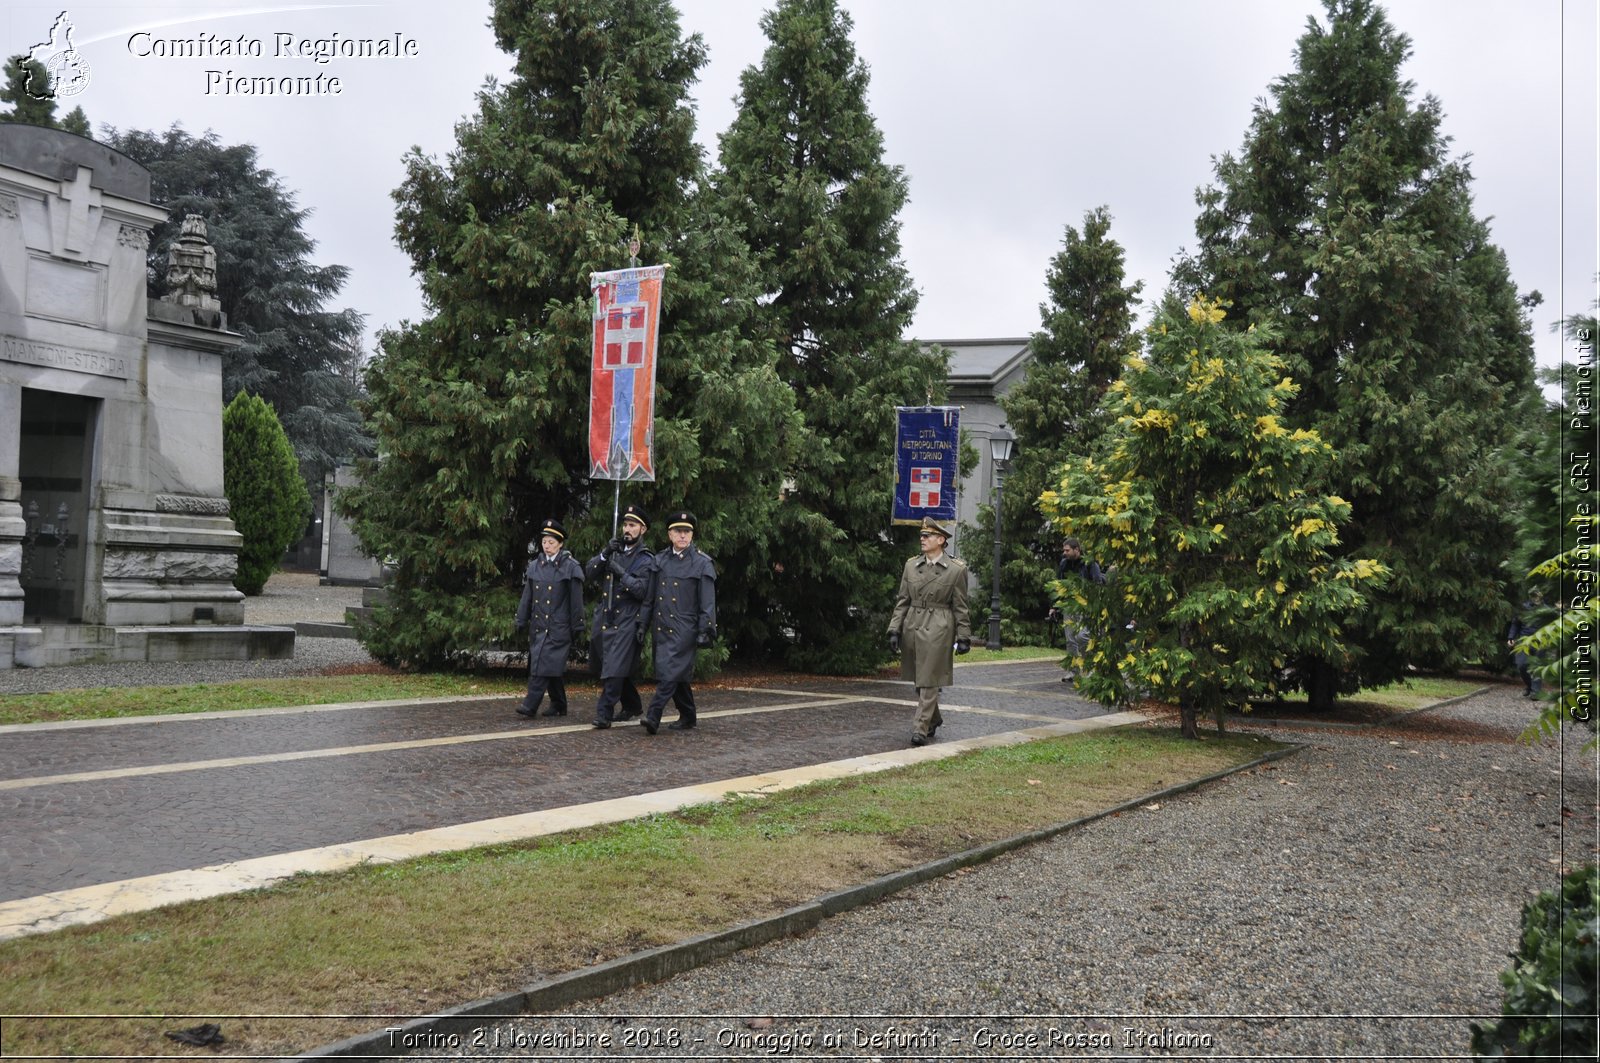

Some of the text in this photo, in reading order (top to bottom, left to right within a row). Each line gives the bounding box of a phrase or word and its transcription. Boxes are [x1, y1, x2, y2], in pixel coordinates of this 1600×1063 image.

[3, 339, 126, 375] MANZONI-STRADA
[911, 451, 943, 461] DI TORINO
